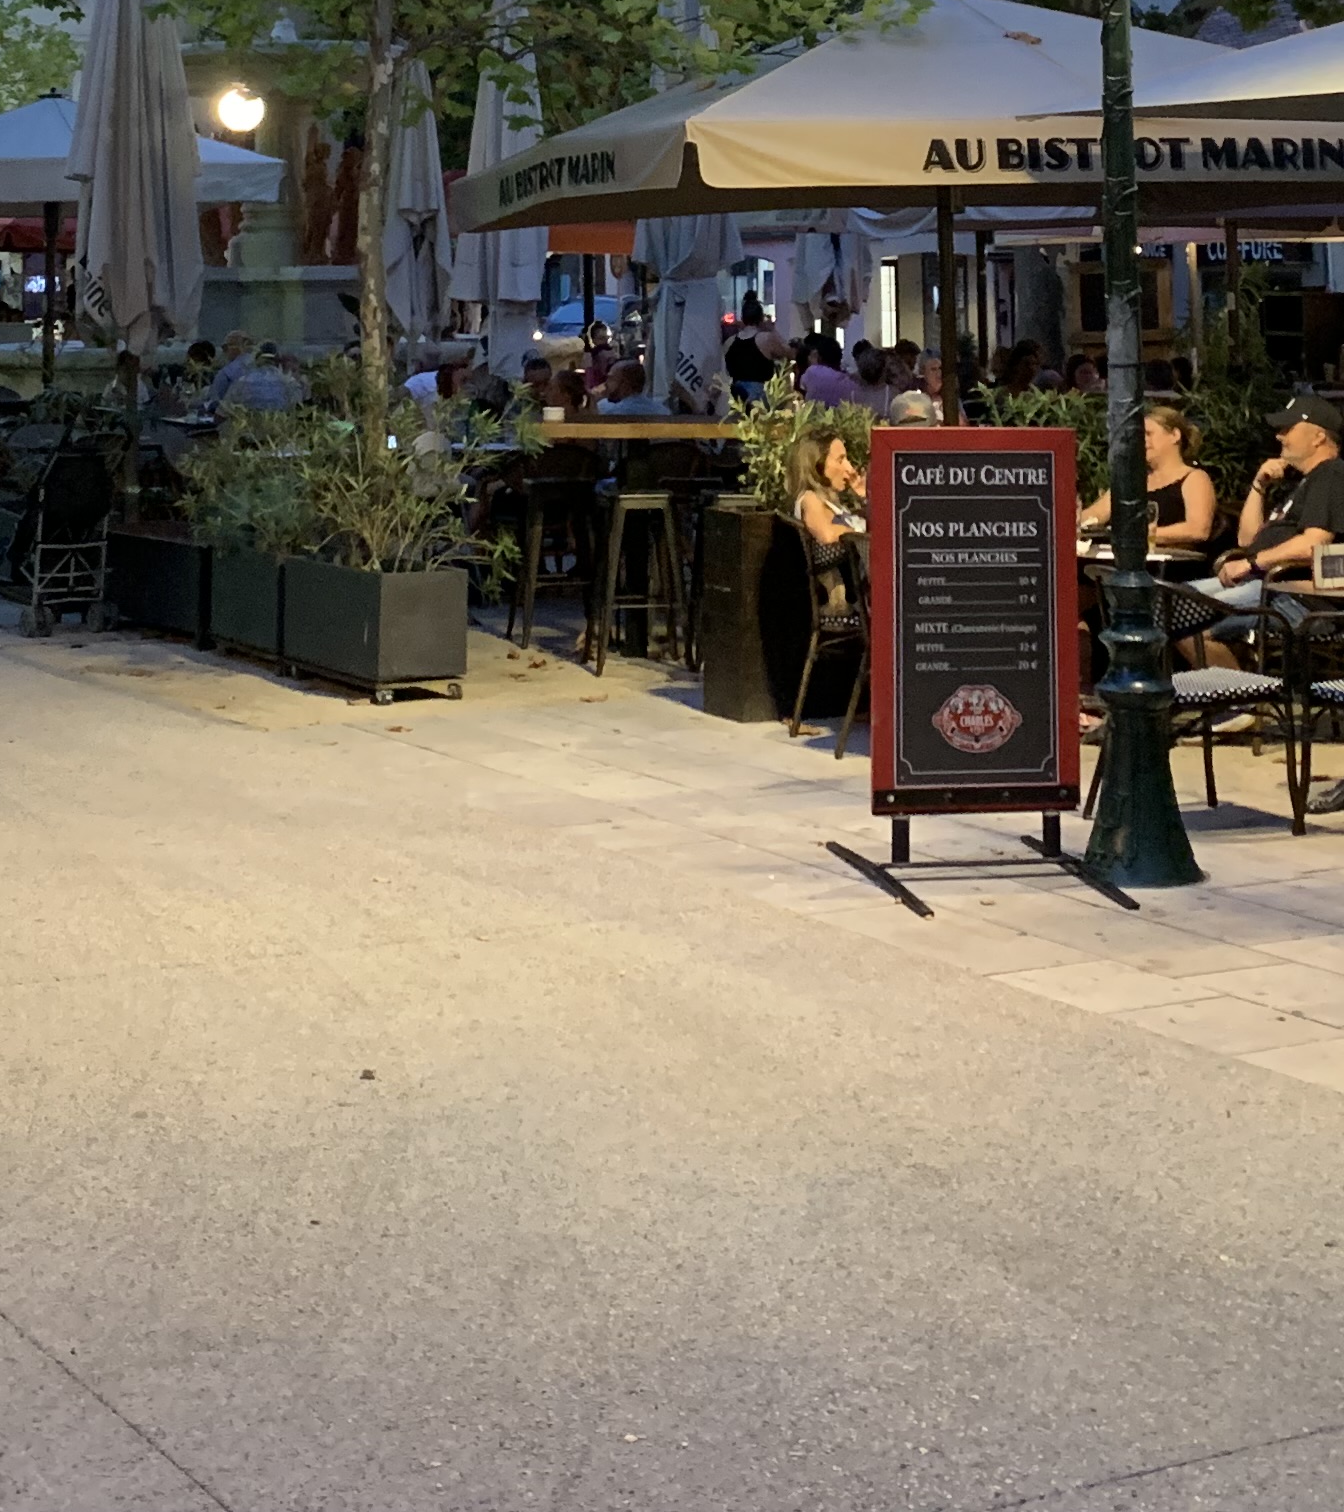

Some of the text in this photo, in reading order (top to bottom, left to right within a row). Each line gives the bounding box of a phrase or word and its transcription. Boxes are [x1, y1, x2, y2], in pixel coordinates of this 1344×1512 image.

[922, 138, 986, 172] AU
[996, 137, 1192, 172] BISTOT
[499, 151, 616, 207] AU BISTROT MARIN
[1206, 242, 1283, 261] COFURE
[901, 464, 1048, 485] CAFÉ DU CENTRE
[908, 521, 1038, 537] NOS PLANCHES
[931, 552, 1018, 563] NOS PLANCHES
[915, 623, 949, 633] MIXTE
